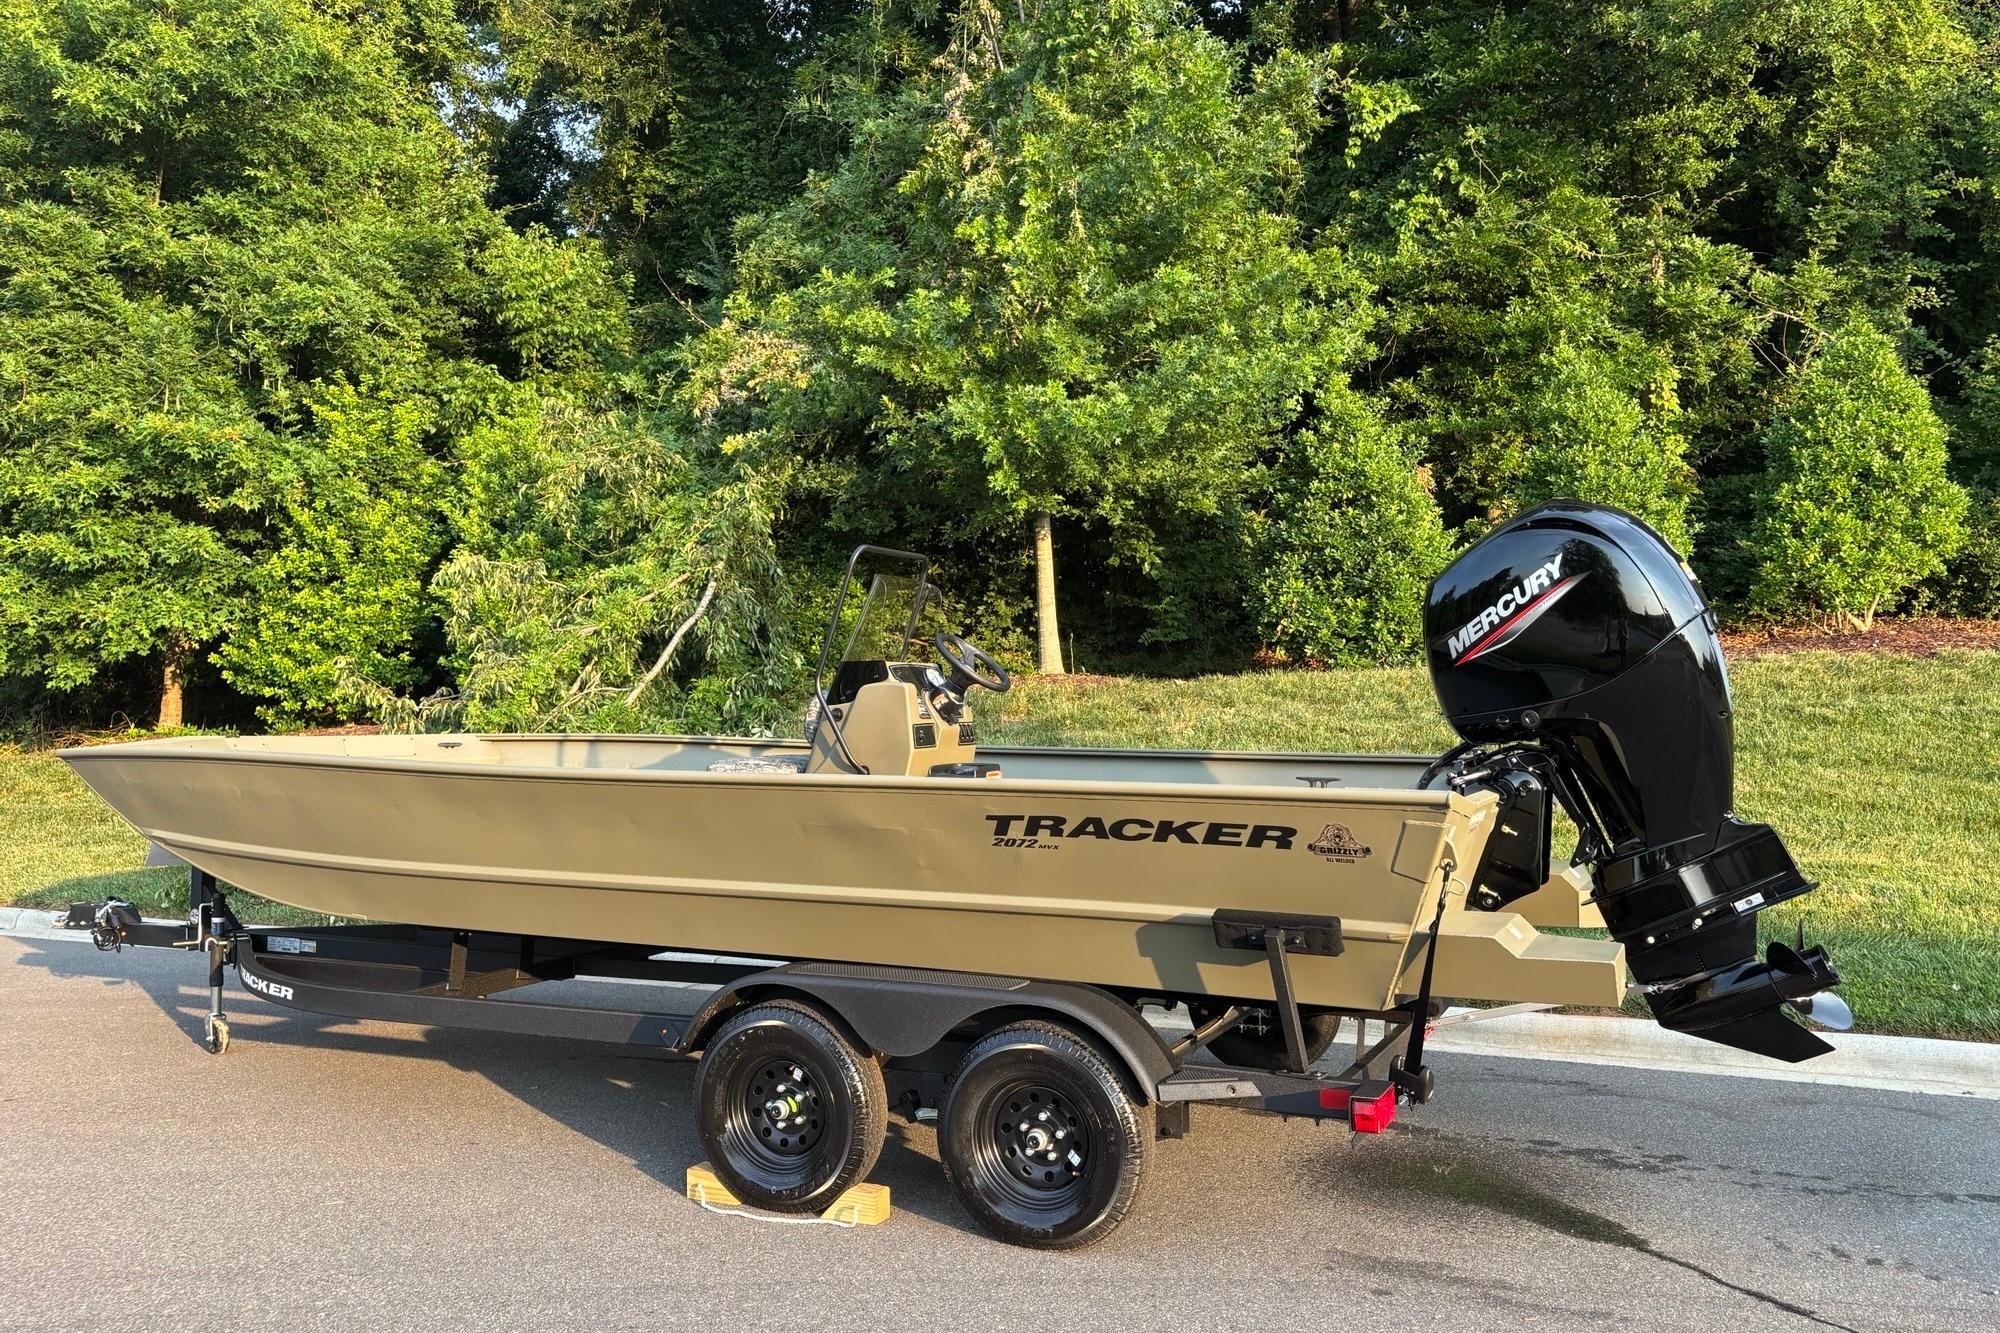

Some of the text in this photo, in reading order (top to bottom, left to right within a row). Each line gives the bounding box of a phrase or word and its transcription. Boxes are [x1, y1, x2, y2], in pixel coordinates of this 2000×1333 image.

[1447, 552, 1563, 659] MERCURY
[985, 815, 1297, 850] TRACKER
[992, 838, 1039, 848] 2072
[1320, 847, 1358, 855] GRIZZLY
[240, 962, 294, 1000] RACKER
